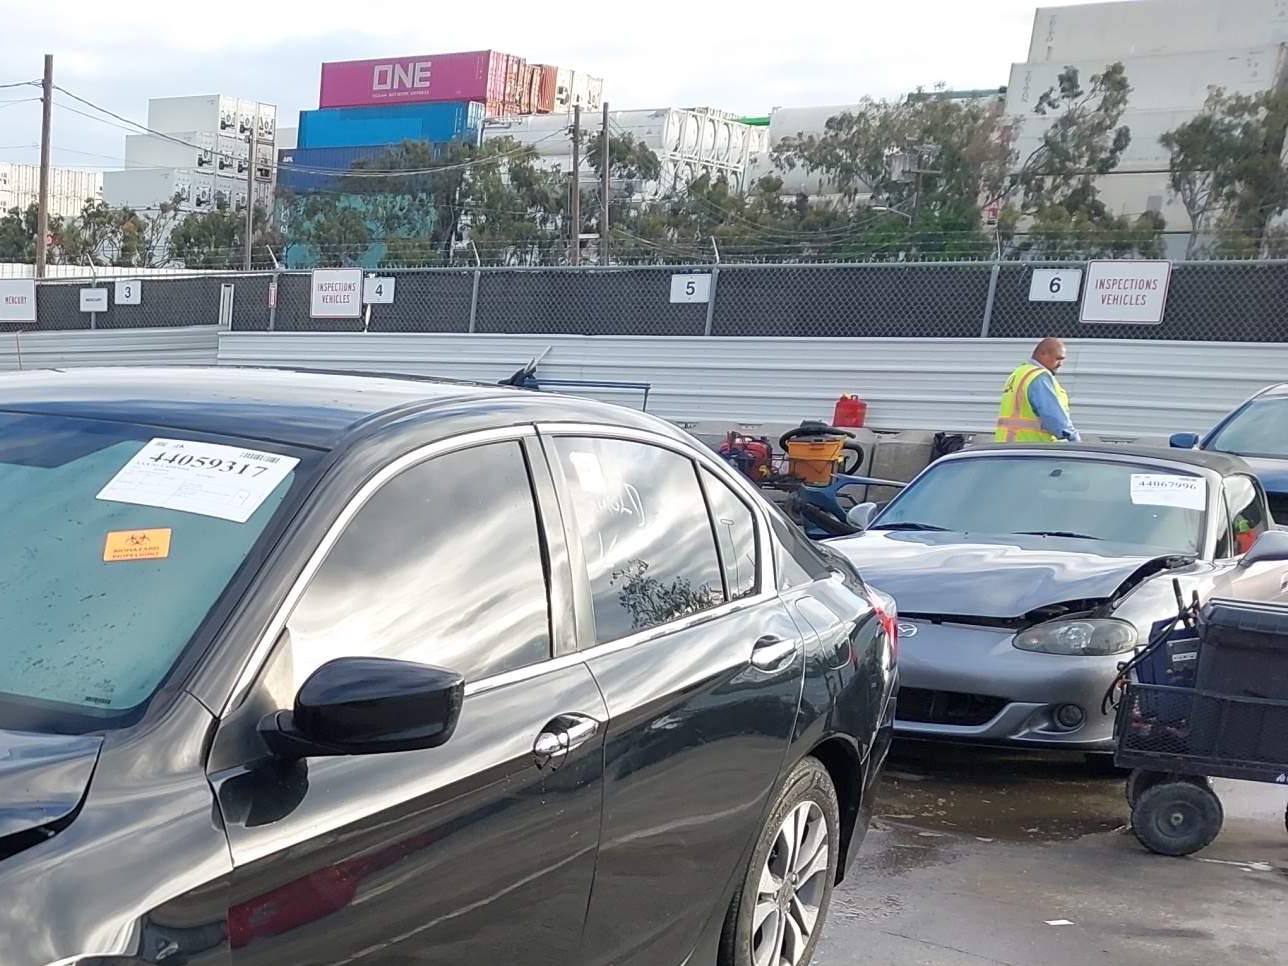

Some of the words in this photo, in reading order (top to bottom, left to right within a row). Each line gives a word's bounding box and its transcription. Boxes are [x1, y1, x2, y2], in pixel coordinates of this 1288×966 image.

[372, 62, 432, 90] ONE
[317, 283, 356, 292] INSPECTIONS
[375, 284, 384, 297] 4
[685, 281, 696, 296] 5
[1049, 277, 1062, 293] 6
[1095, 279, 1158, 291] INSPECTIONS
[124, 286, 132, 298] 3
[321, 294, 350, 304] VEHICLES
[1101, 294, 1147, 305] VEHICLES
[149, 452, 268, 478] 44059317
